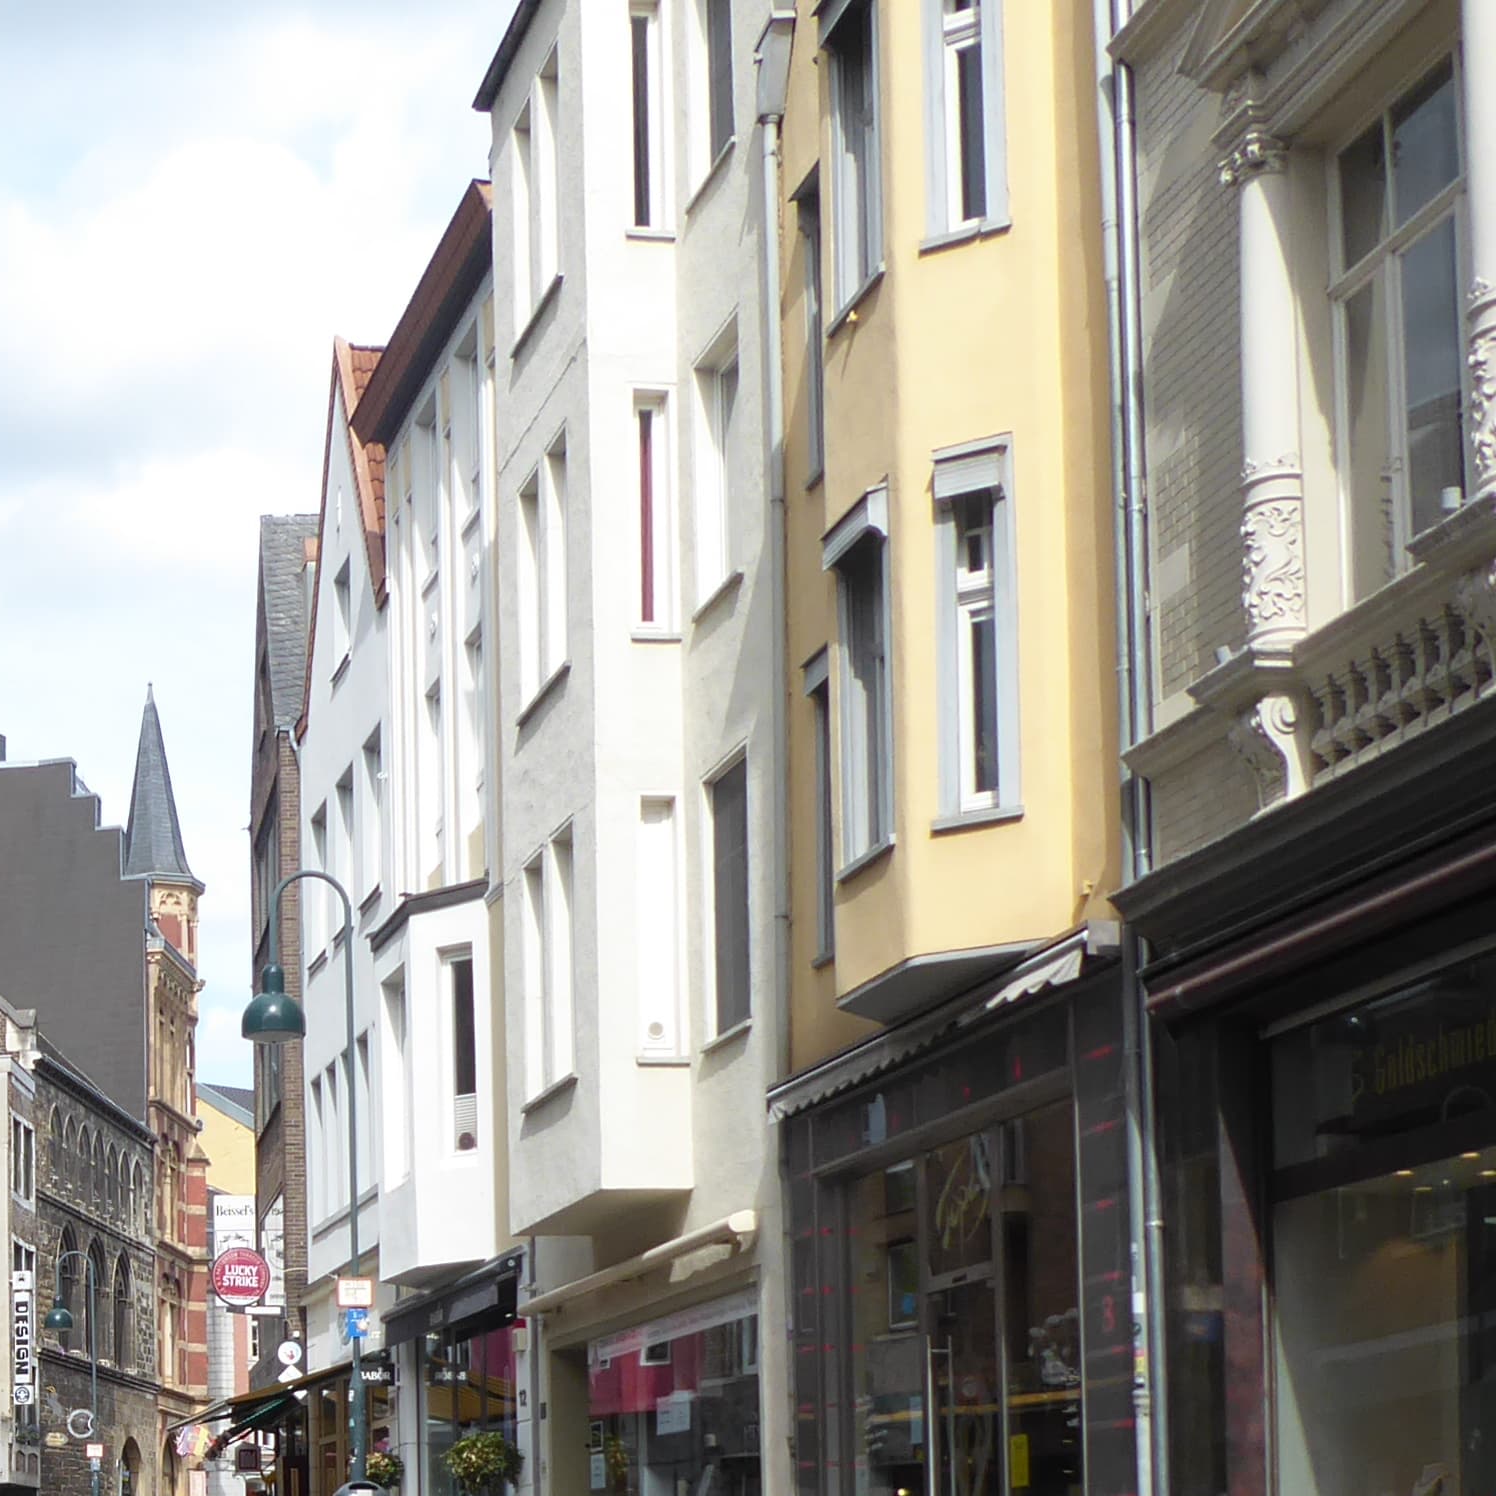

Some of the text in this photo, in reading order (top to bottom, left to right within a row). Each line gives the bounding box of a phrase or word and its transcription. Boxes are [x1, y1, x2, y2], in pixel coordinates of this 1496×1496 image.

[224, 1264, 259, 1276] LUCKY
[222, 1275, 259, 1288] STRIKE
[15, 1300, 29, 1375] DESIGN
